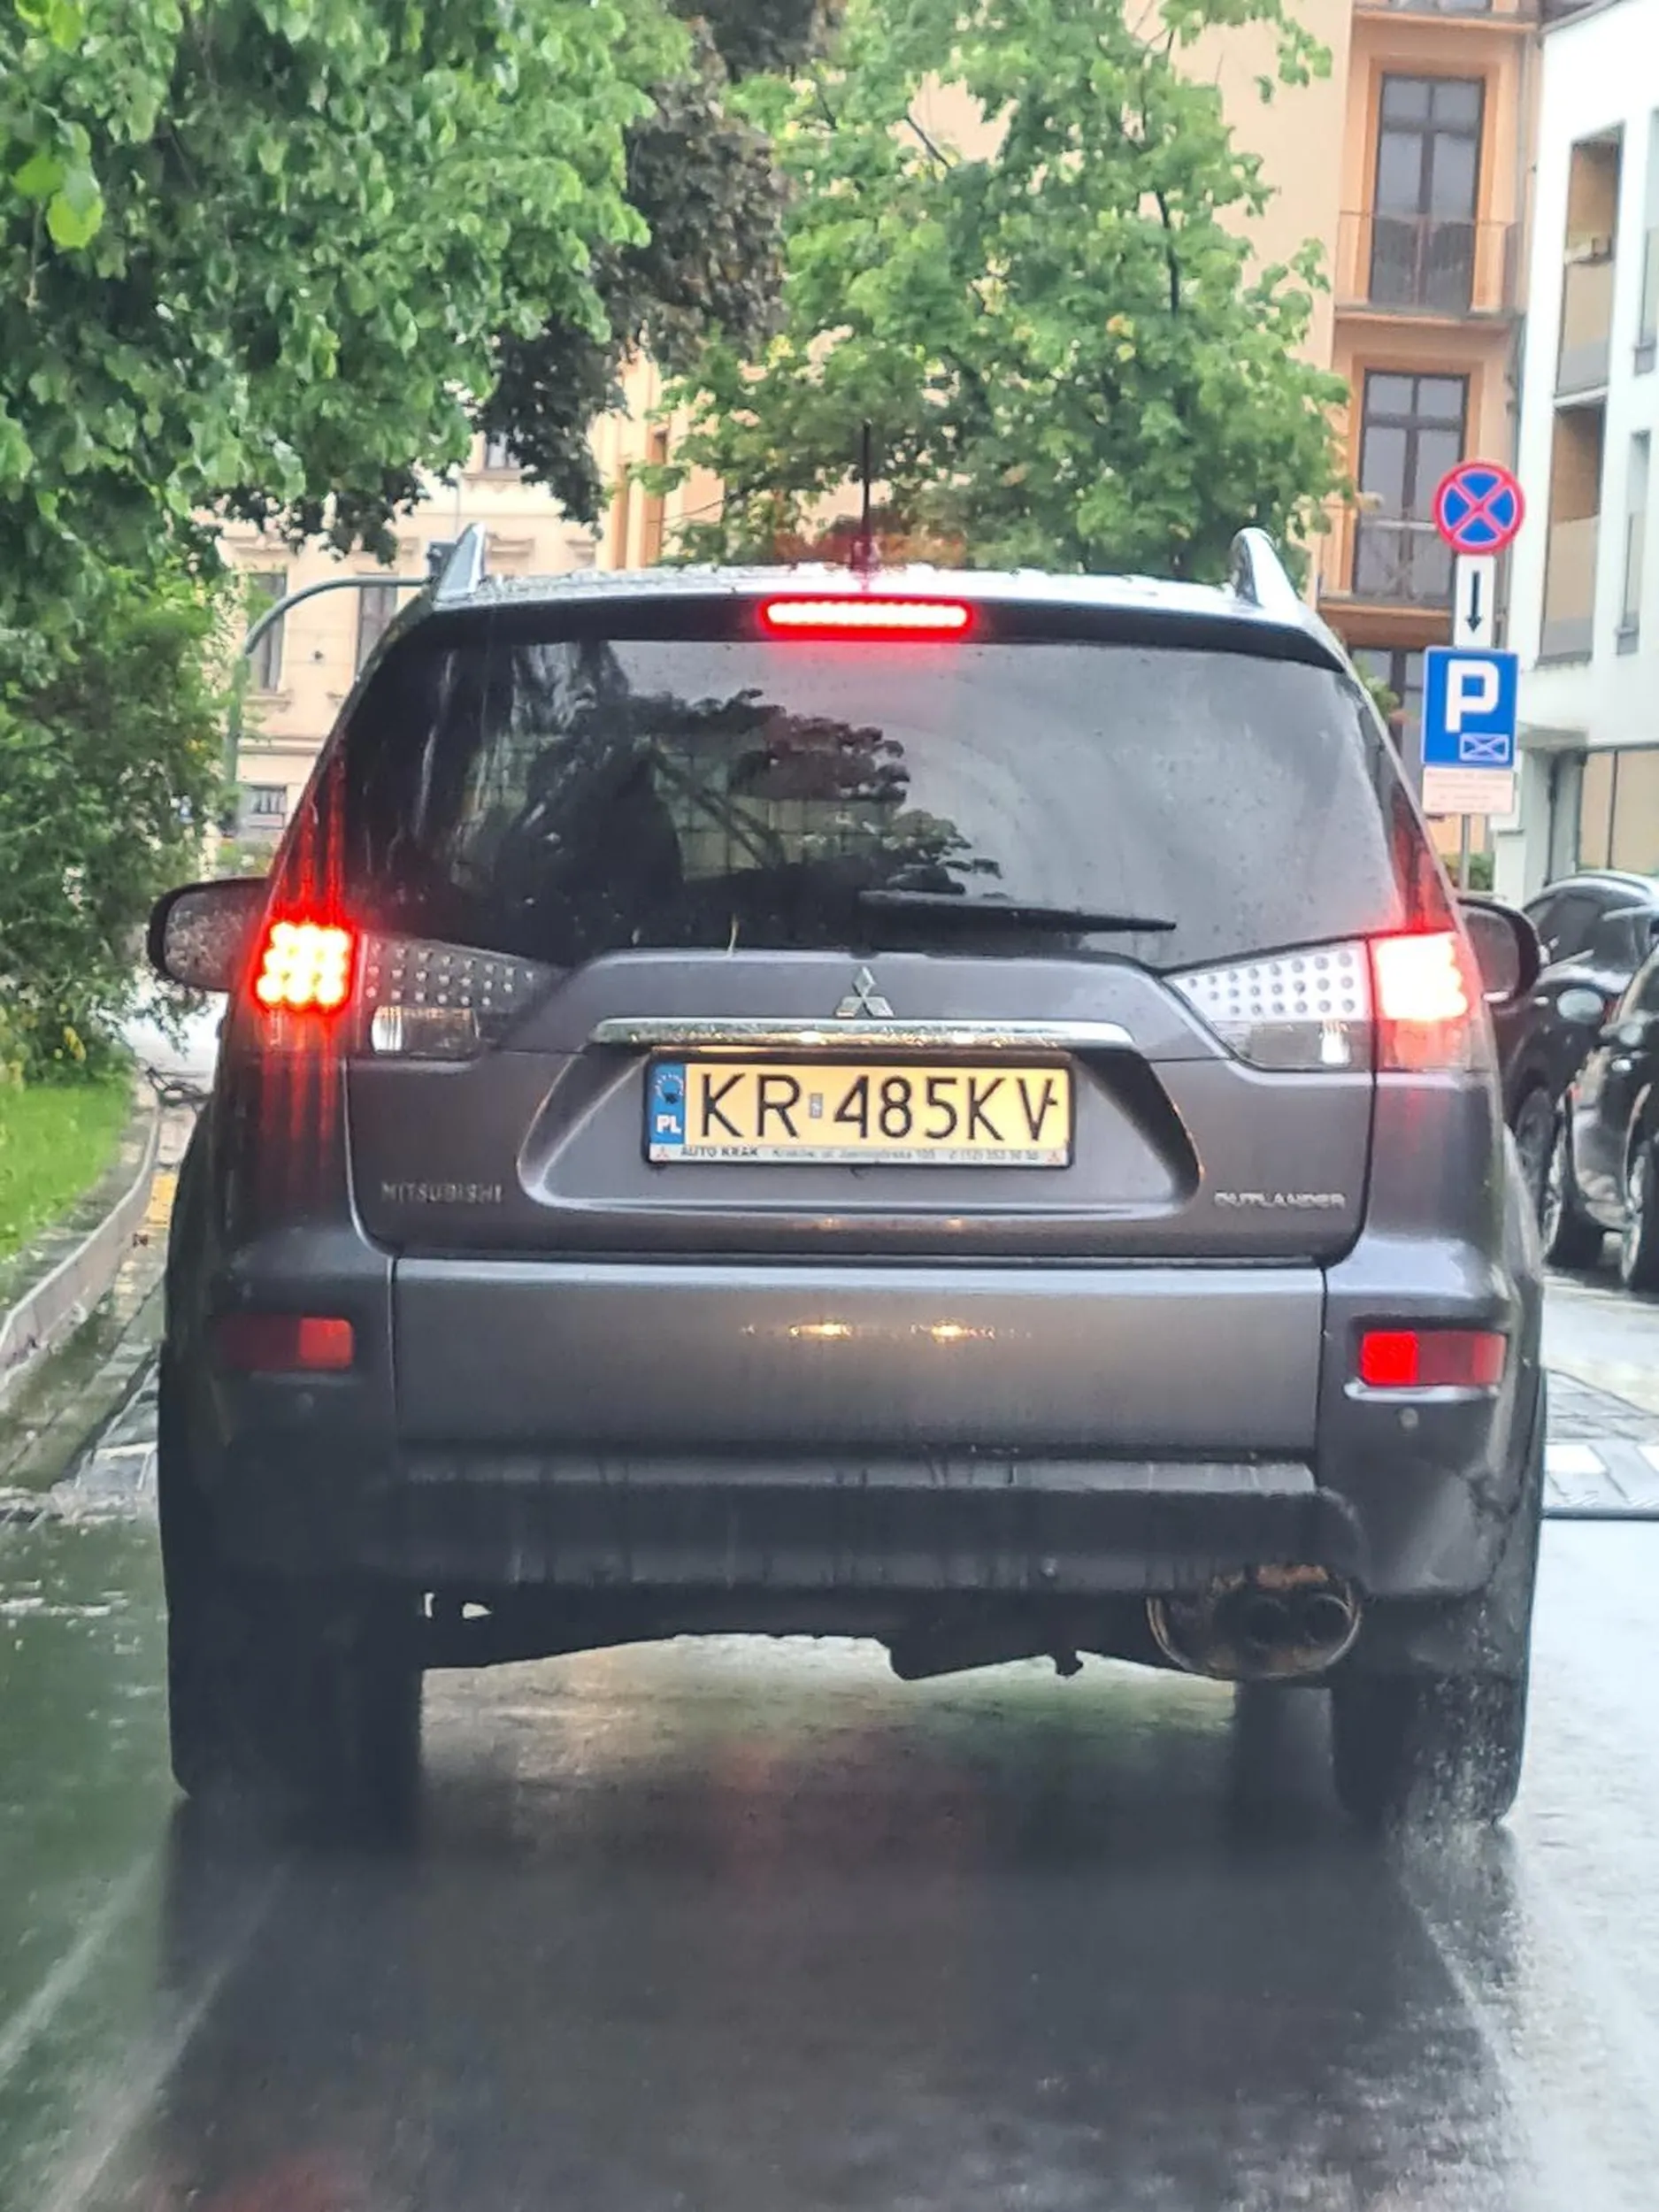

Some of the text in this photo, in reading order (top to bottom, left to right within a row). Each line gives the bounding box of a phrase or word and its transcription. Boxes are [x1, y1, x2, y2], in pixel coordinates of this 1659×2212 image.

[1445, 658, 1499, 733] P
[657, 1114, 682, 1134] PL
[701, 1072, 1058, 1141] KR 485KV
